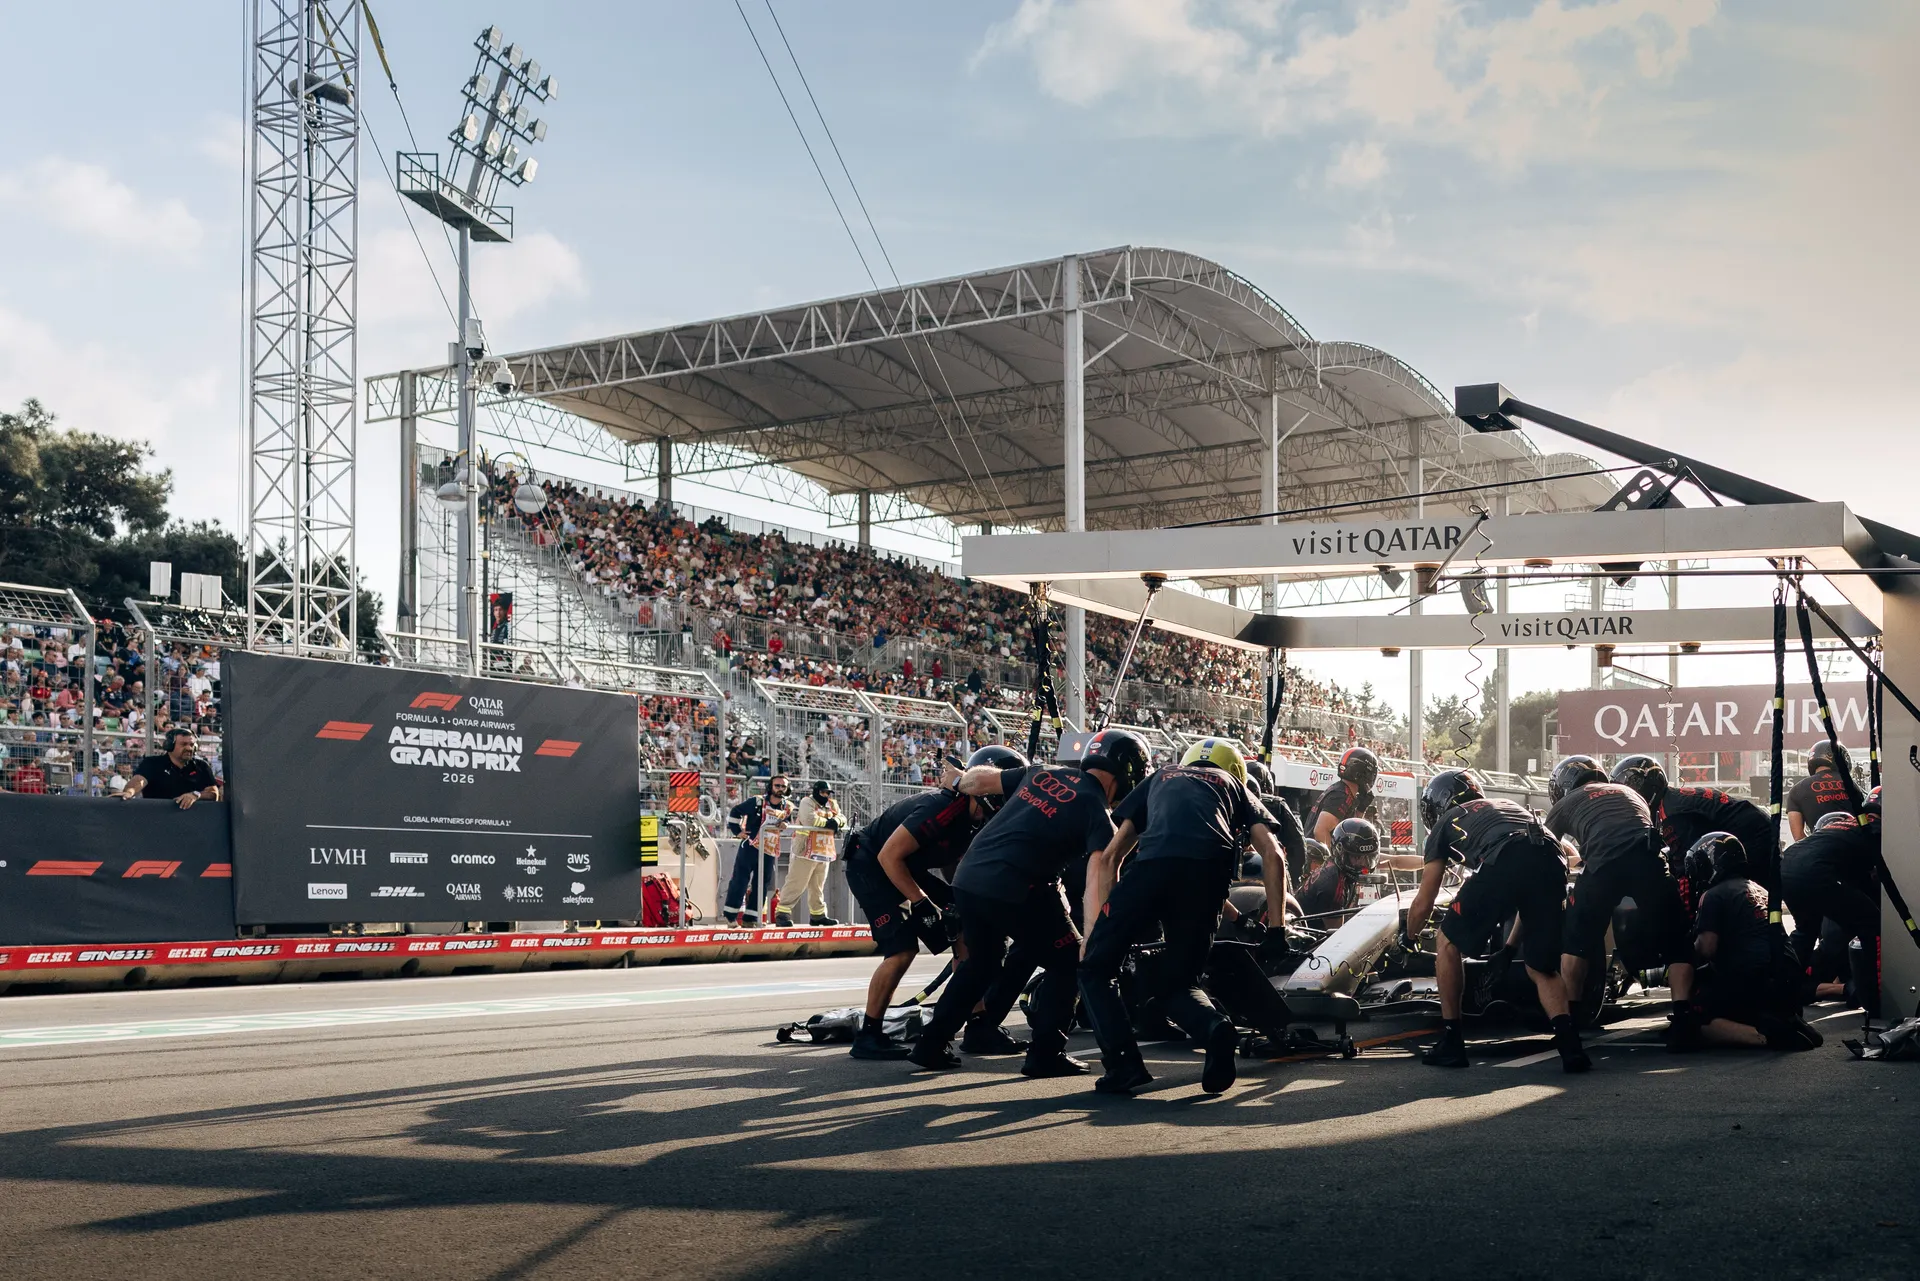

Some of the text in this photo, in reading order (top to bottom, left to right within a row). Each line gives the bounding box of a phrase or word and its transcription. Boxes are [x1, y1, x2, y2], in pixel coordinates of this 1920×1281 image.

[469, 696, 504, 710] QATAR
[477, 708, 504, 717] AIRWAYS
[396, 712, 516, 731] FORMULA 1 QATAR AIRWAYS
[1594, 697, 1876, 746] QATAR AIRW
[388, 725, 523, 754] AZERBAIJAN
[390, 745, 521, 773] GRAND PRIX
[442, 772, 475, 784] 2026
[1016, 785, 1057, 818] Revolut
[403, 815, 429, 824] GLOBAL
[430, 816, 464, 825] PARTNERS
[474, 818, 505, 827] FORMULA
[309, 847, 367, 866] LVMH
[390, 852, 428, 864] PIRELLI
[451, 854, 496, 865] aramco
[516, 857, 546, 866] Heineken
[567, 853, 590, 865] aws
[311, 886, 344, 896] Lenovo
[378, 886, 418, 897] DHL
[446, 883, 481, 895] QATAR
[517, 886, 543, 898] MSC
[455, 893, 482, 901] AIRWAYS
[562, 895, 594, 906] salesforce
